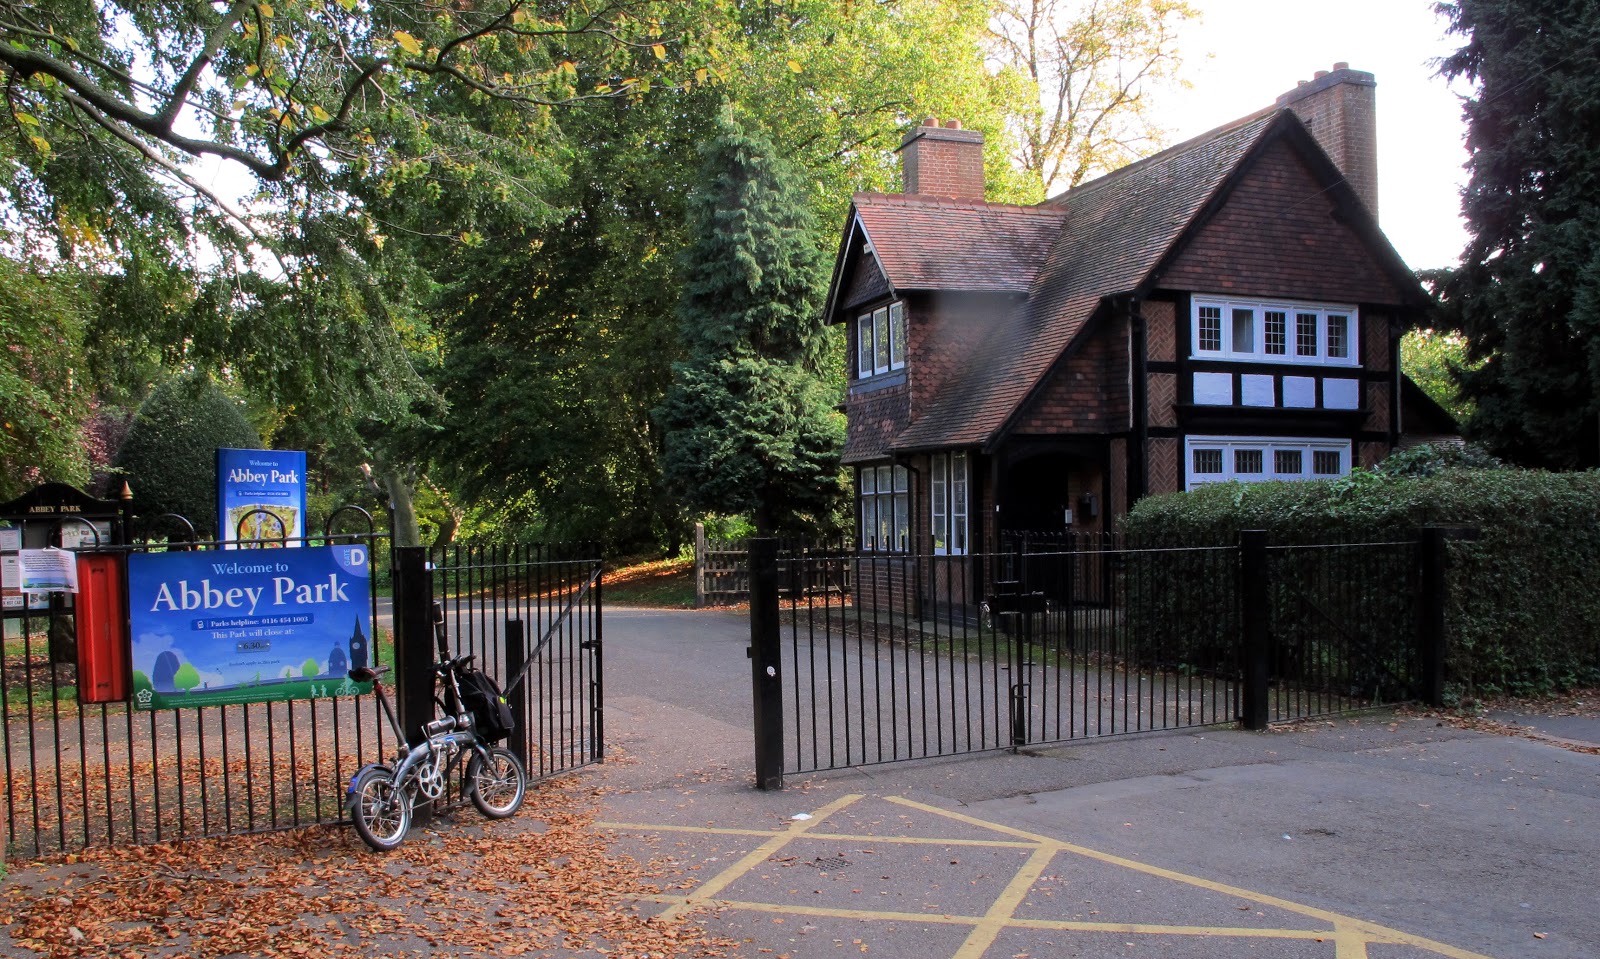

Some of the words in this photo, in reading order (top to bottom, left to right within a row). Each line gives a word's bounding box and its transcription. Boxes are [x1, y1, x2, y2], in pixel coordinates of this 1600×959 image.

[228, 469, 268, 486] Abbey
[271, 470, 299, 484] Park
[351, 548, 364, 566] D
[212, 562, 272, 575] Welcome
[276, 562, 288, 572] to
[150, 579, 263, 615] Abbey
[273, 573, 350, 606] Park
[249, 629, 262, 637] will
